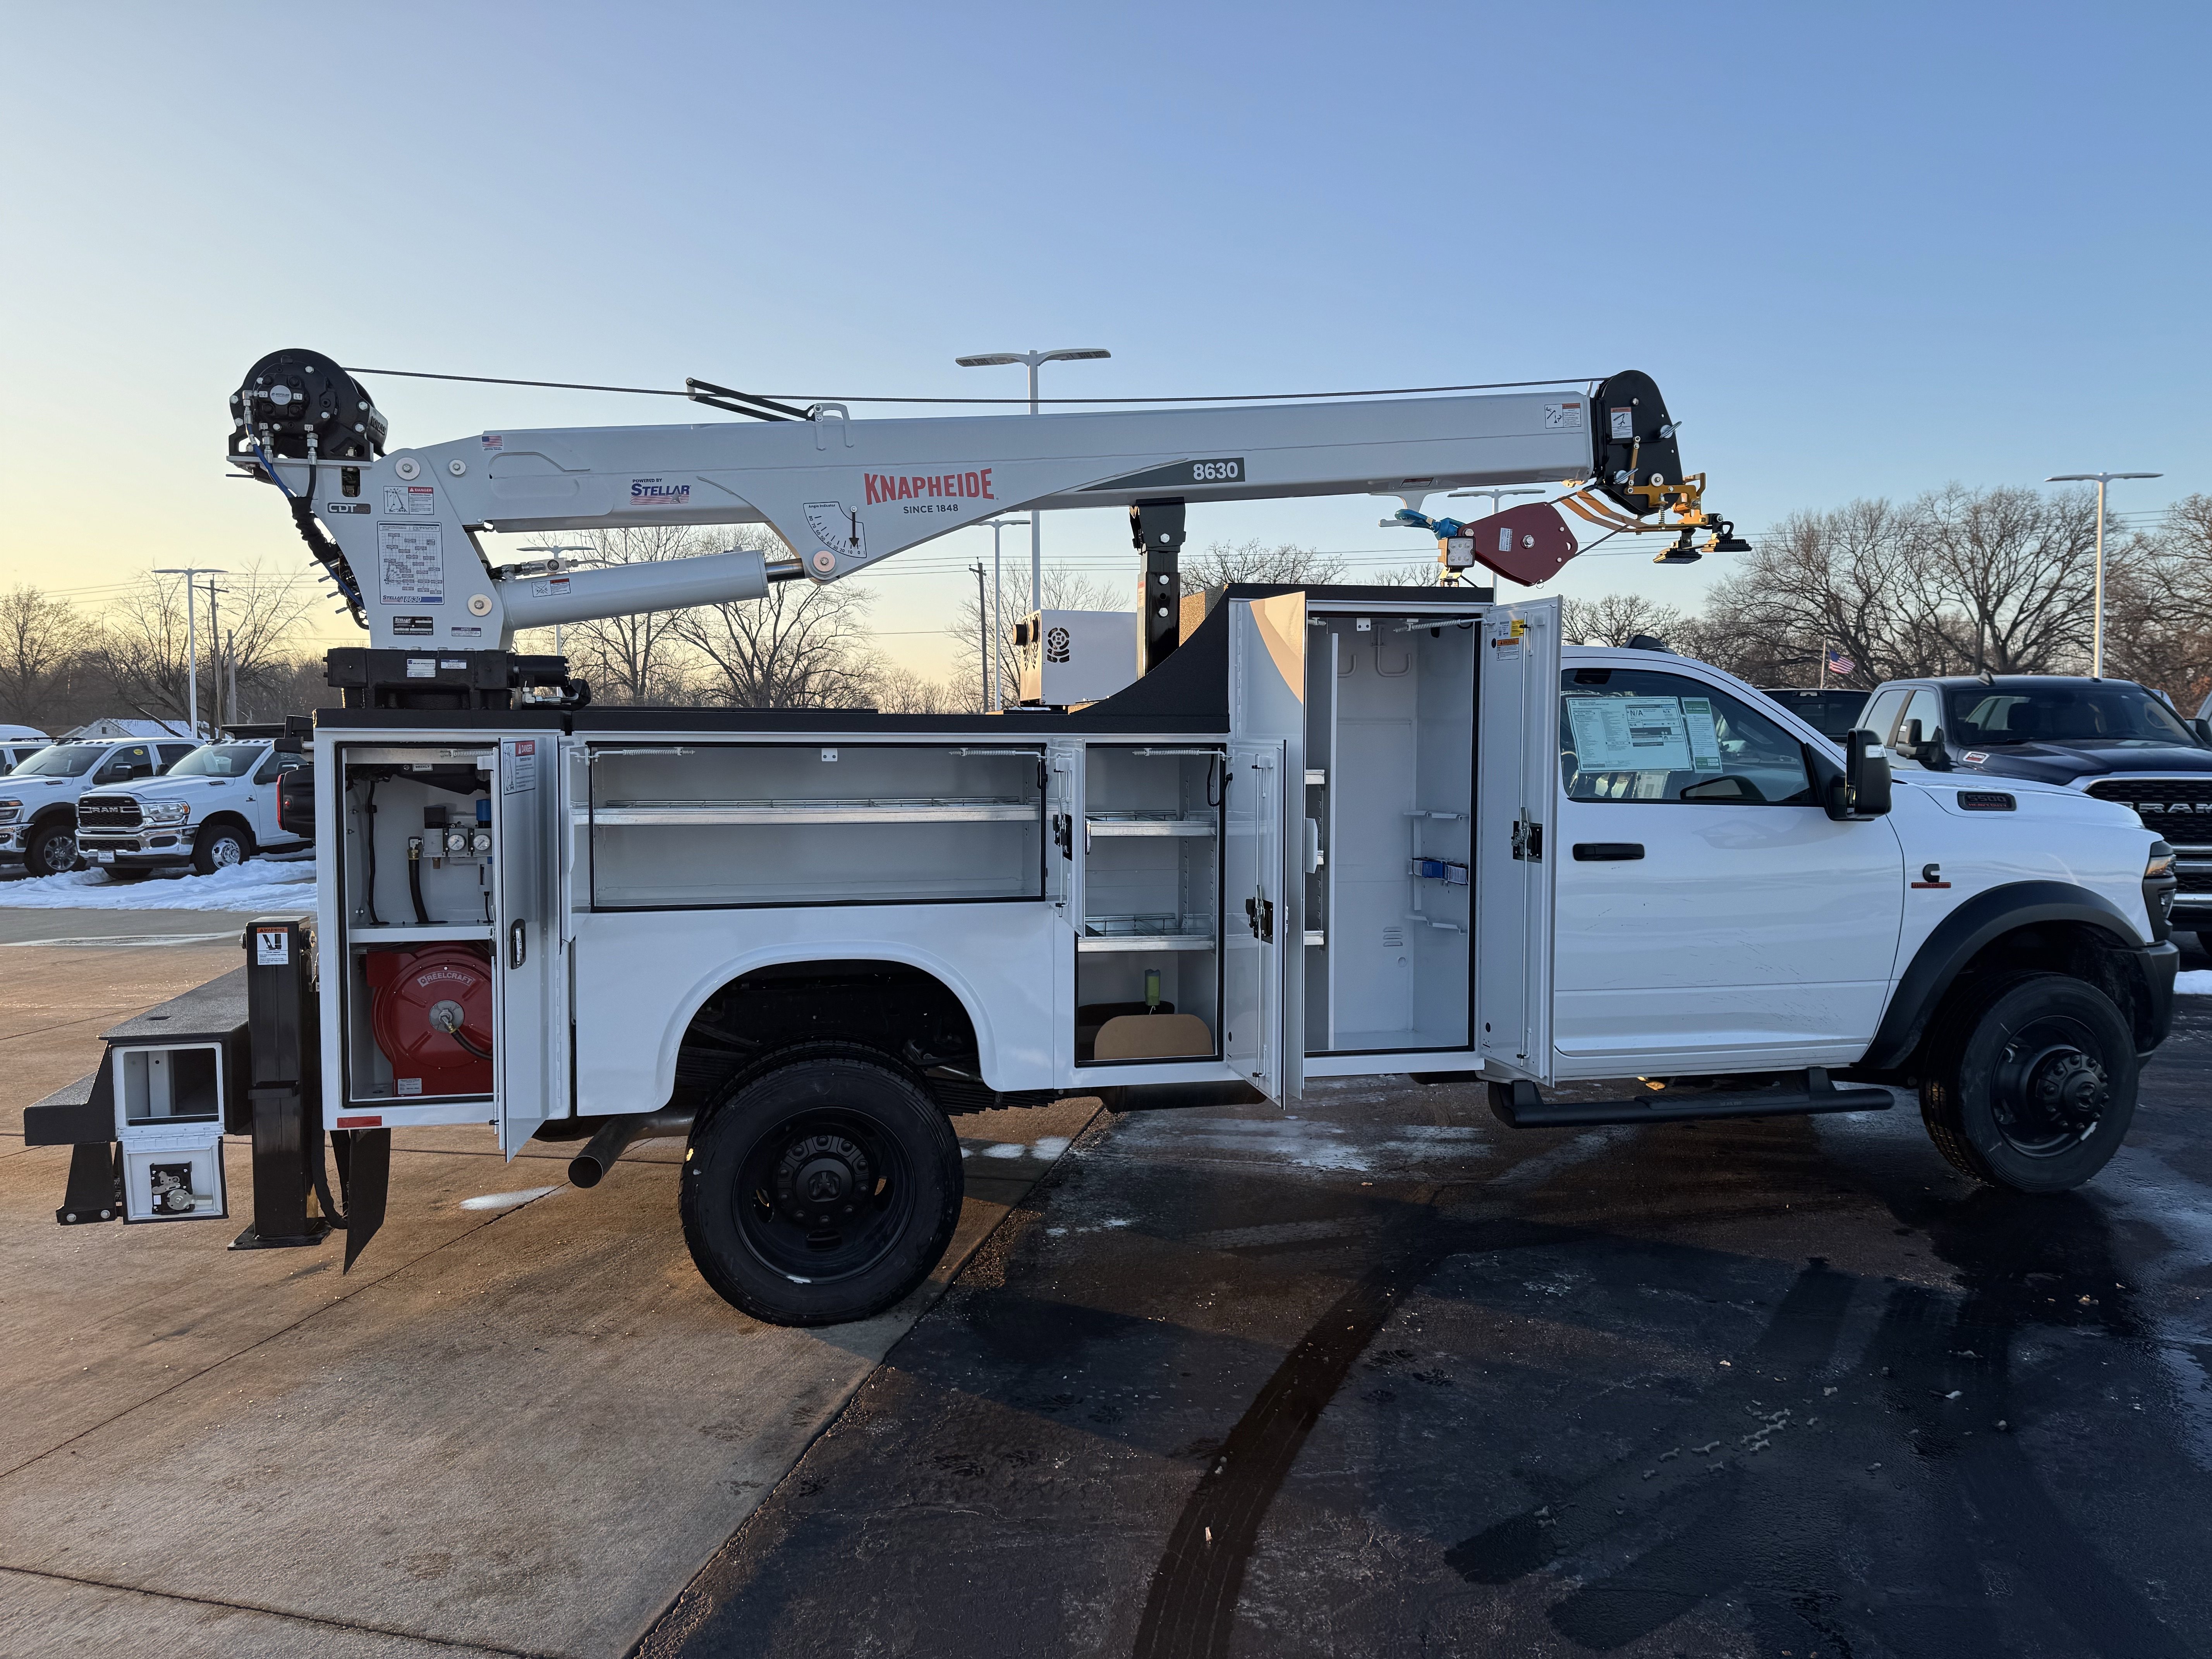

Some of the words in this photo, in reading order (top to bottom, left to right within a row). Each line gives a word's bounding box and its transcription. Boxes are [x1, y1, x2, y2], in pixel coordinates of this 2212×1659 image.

[1193, 462, 1238, 480] 8630
[631, 483, 690, 496] STELLAR
[864, 468, 994, 505] KNAPHEIDE
[903, 505, 933, 514] SINCE
[936, 504, 958, 512] 1848
[426, 972, 472, 984] REELCRAFT
